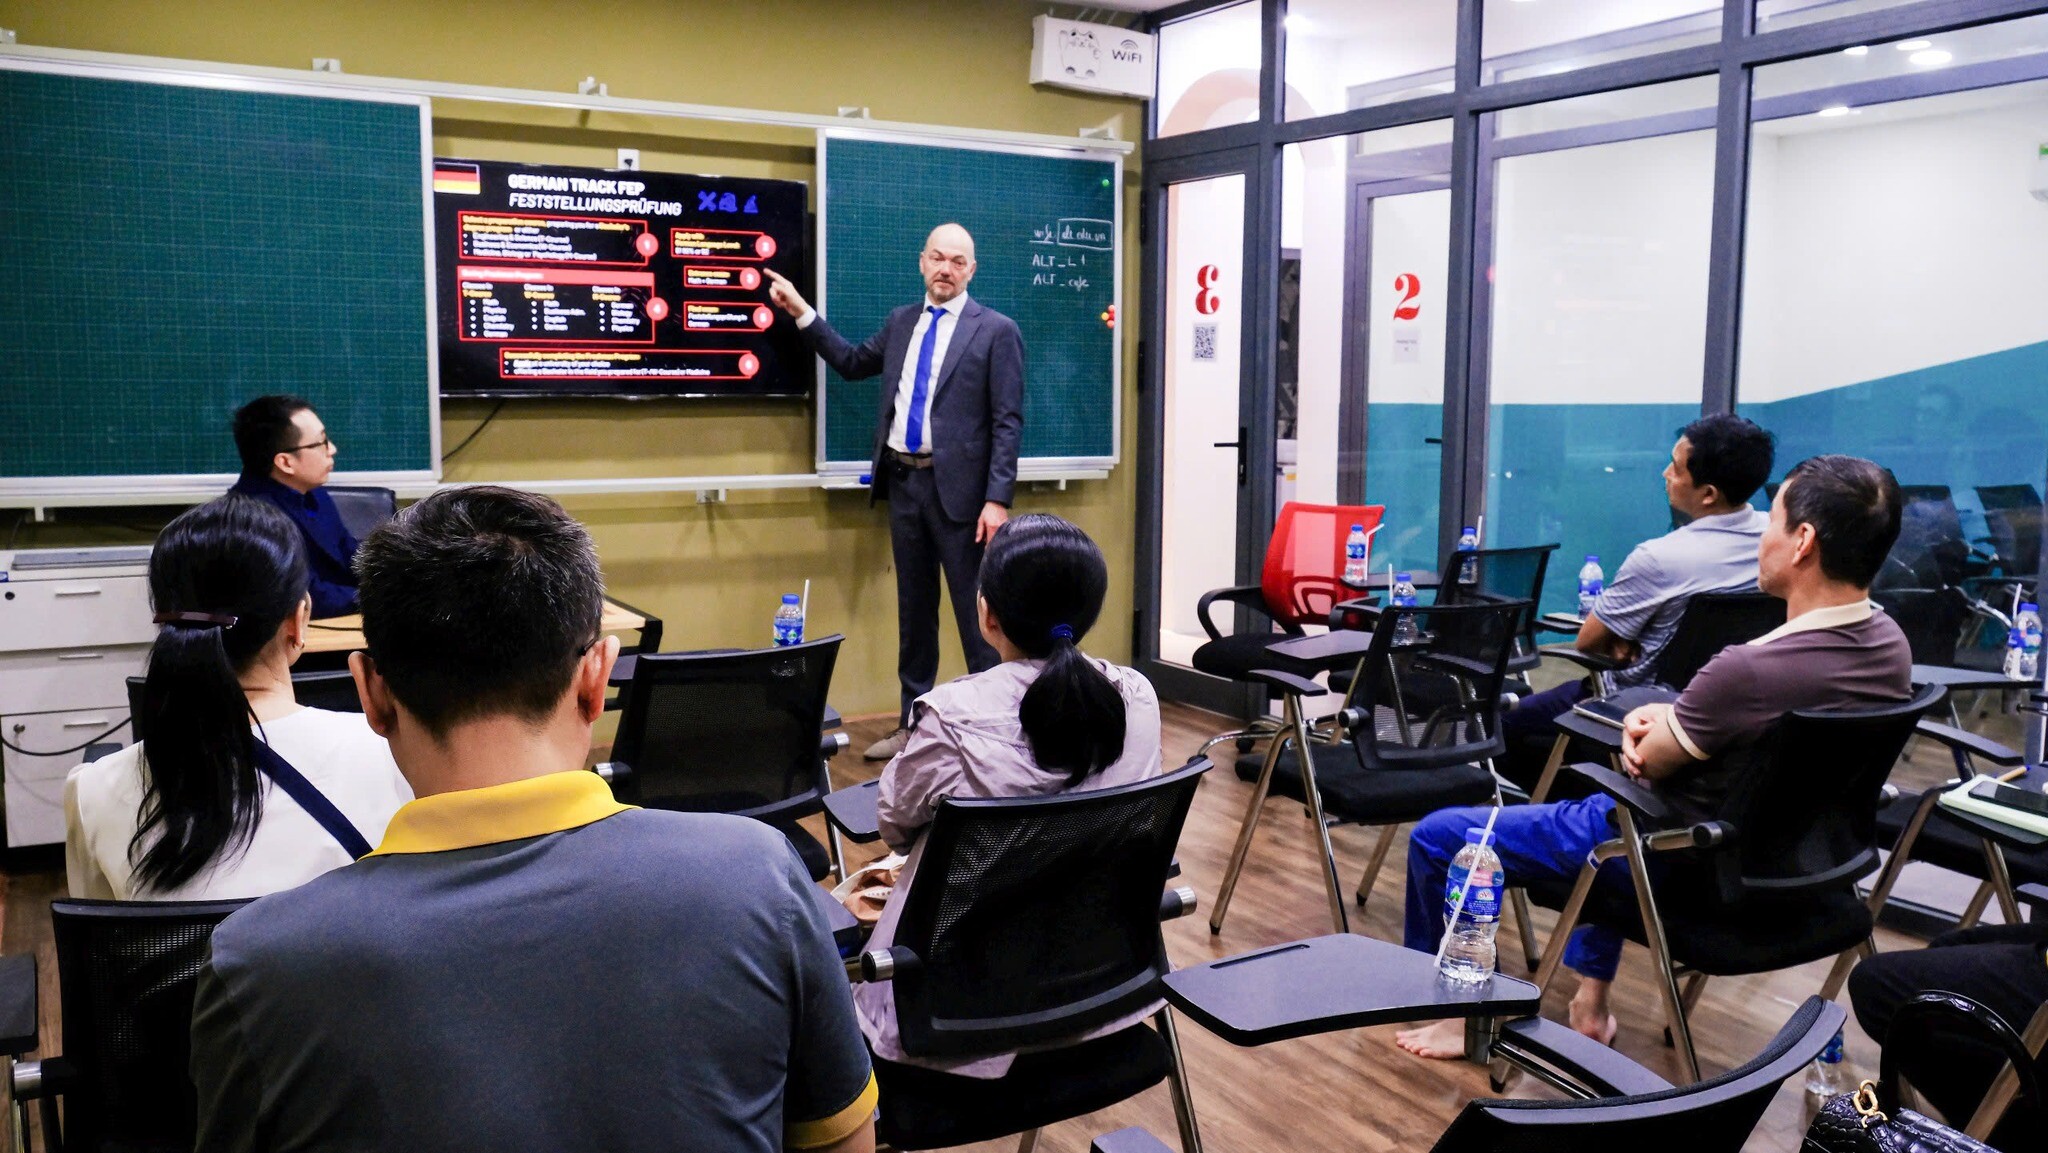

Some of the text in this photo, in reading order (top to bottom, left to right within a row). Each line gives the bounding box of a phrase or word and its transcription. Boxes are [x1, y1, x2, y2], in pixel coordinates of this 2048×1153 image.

[508, 174, 645, 196] GERMAN TRACK FEP
[509, 193, 682, 216] FESTSTELLUNGSPRÜFUNG
[1393, 273, 1421, 320] 2
